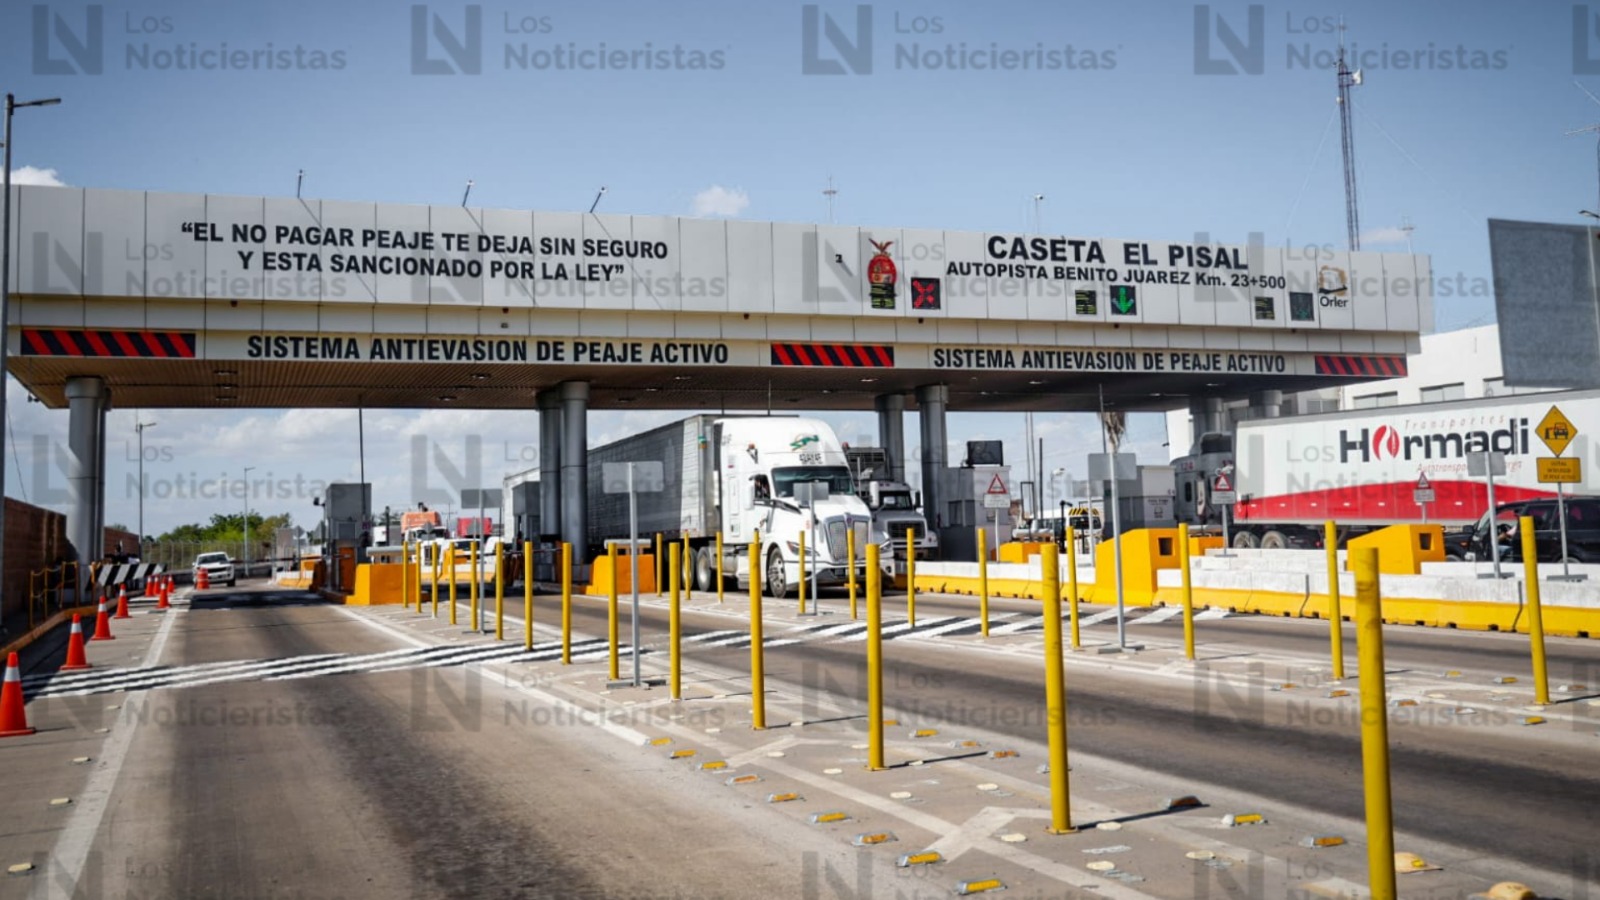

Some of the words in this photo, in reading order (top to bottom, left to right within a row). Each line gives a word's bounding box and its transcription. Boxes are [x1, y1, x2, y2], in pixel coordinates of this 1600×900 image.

[231, 223, 267, 243] NO
[275, 225, 354, 247] PAGAR
[362, 229, 434, 250] PEAJE
[441, 232, 469, 251] TE
[477, 234, 533, 254] DEJA
[540, 237, 575, 256] SIN
[583, 238, 668, 259] SEGURO
[987, 235, 1106, 264] CASETA
[1123, 242, 1158, 266] EL
[1168, 244, 1248, 270] PISAL
[237, 250, 254, 270] Y
[262, 251, 322, 272] ESTA
[330, 253, 482, 278] SANCIONADO
[490, 261, 535, 279] POR
[542, 262, 568, 281] LA
[946, 261, 1049, 279] AUTOPISTA
[1053, 266, 1118, 282] BENITO
[1123, 269, 1191, 285] JUAREZ
[1195, 272, 1226, 287] Km.
[1231, 273, 1286, 289] 23+500
[247, 335, 361, 359] SISTEMA
[370, 337, 527, 361] ANTIEVASION
[536, 340, 565, 361] DE
[573, 341, 643, 363] PEAJE
[650, 342, 728, 364] ACTIVO
[933, 348, 1016, 369] SISTEMA
[1021, 349, 1137, 371] ANTIEVASION
[1143, 352, 1165, 371] DE
[1170, 352, 1222, 372] PEAJE
[1227, 353, 1285, 373] ACTIVO
